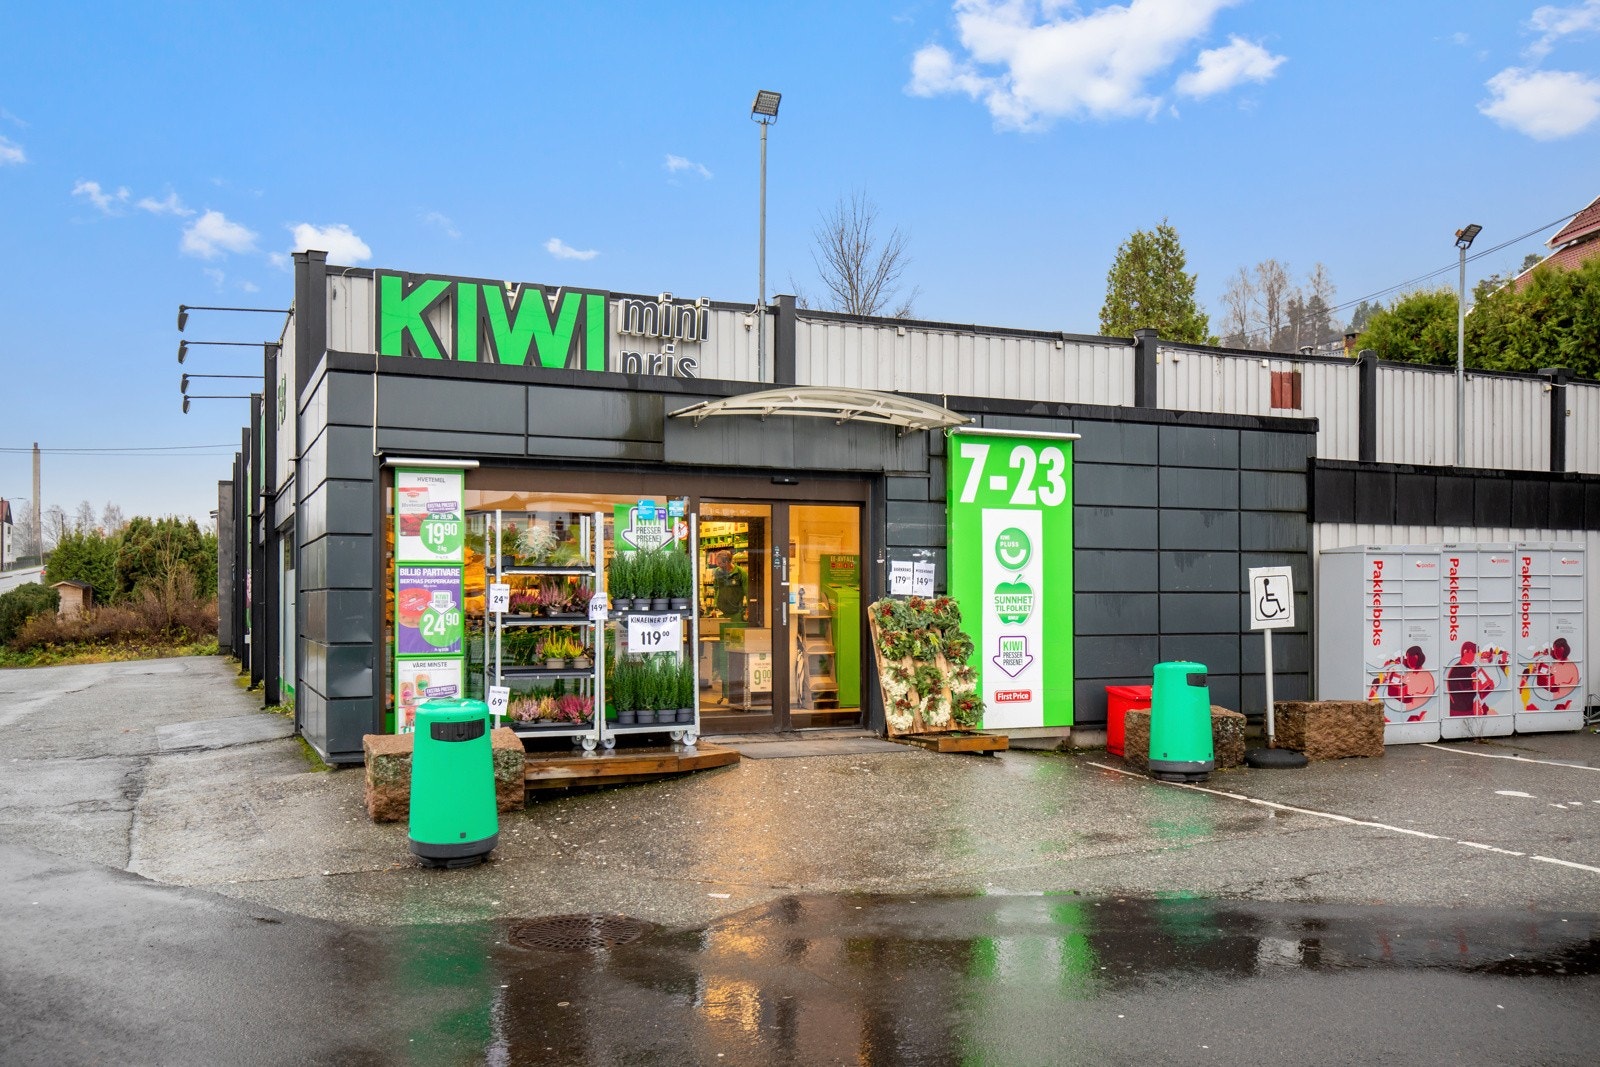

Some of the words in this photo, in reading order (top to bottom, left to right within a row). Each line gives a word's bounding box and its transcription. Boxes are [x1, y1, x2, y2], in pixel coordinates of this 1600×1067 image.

[619, 292, 710, 342] mini
[380, 274, 606, 373] KIWI
[959, 442, 1067, 507] 7-23
[416, 476, 446, 484] HVETEMEL
[636, 526, 661, 534] PRESSER
[636, 534, 662, 543] PRISENE!
[399, 568, 421, 576] BILLIG
[422, 568, 461, 577] PARTIVARE
[994, 595, 1033, 604] SUNNHET
[1449, 558, 1459, 642] Pakkeboks
[1521, 556, 1531, 638] Pakkeboks
[1373, 560, 1383, 646] Pakkeboks
[995, 604, 1006, 612] TIL
[1006, 604, 1032, 612] FOLKET
[669, 615, 678, 623] CM
[1002, 640, 1023, 651] KIWI
[997, 692, 1012, 701] First
[1012, 692, 1029, 700] Price
